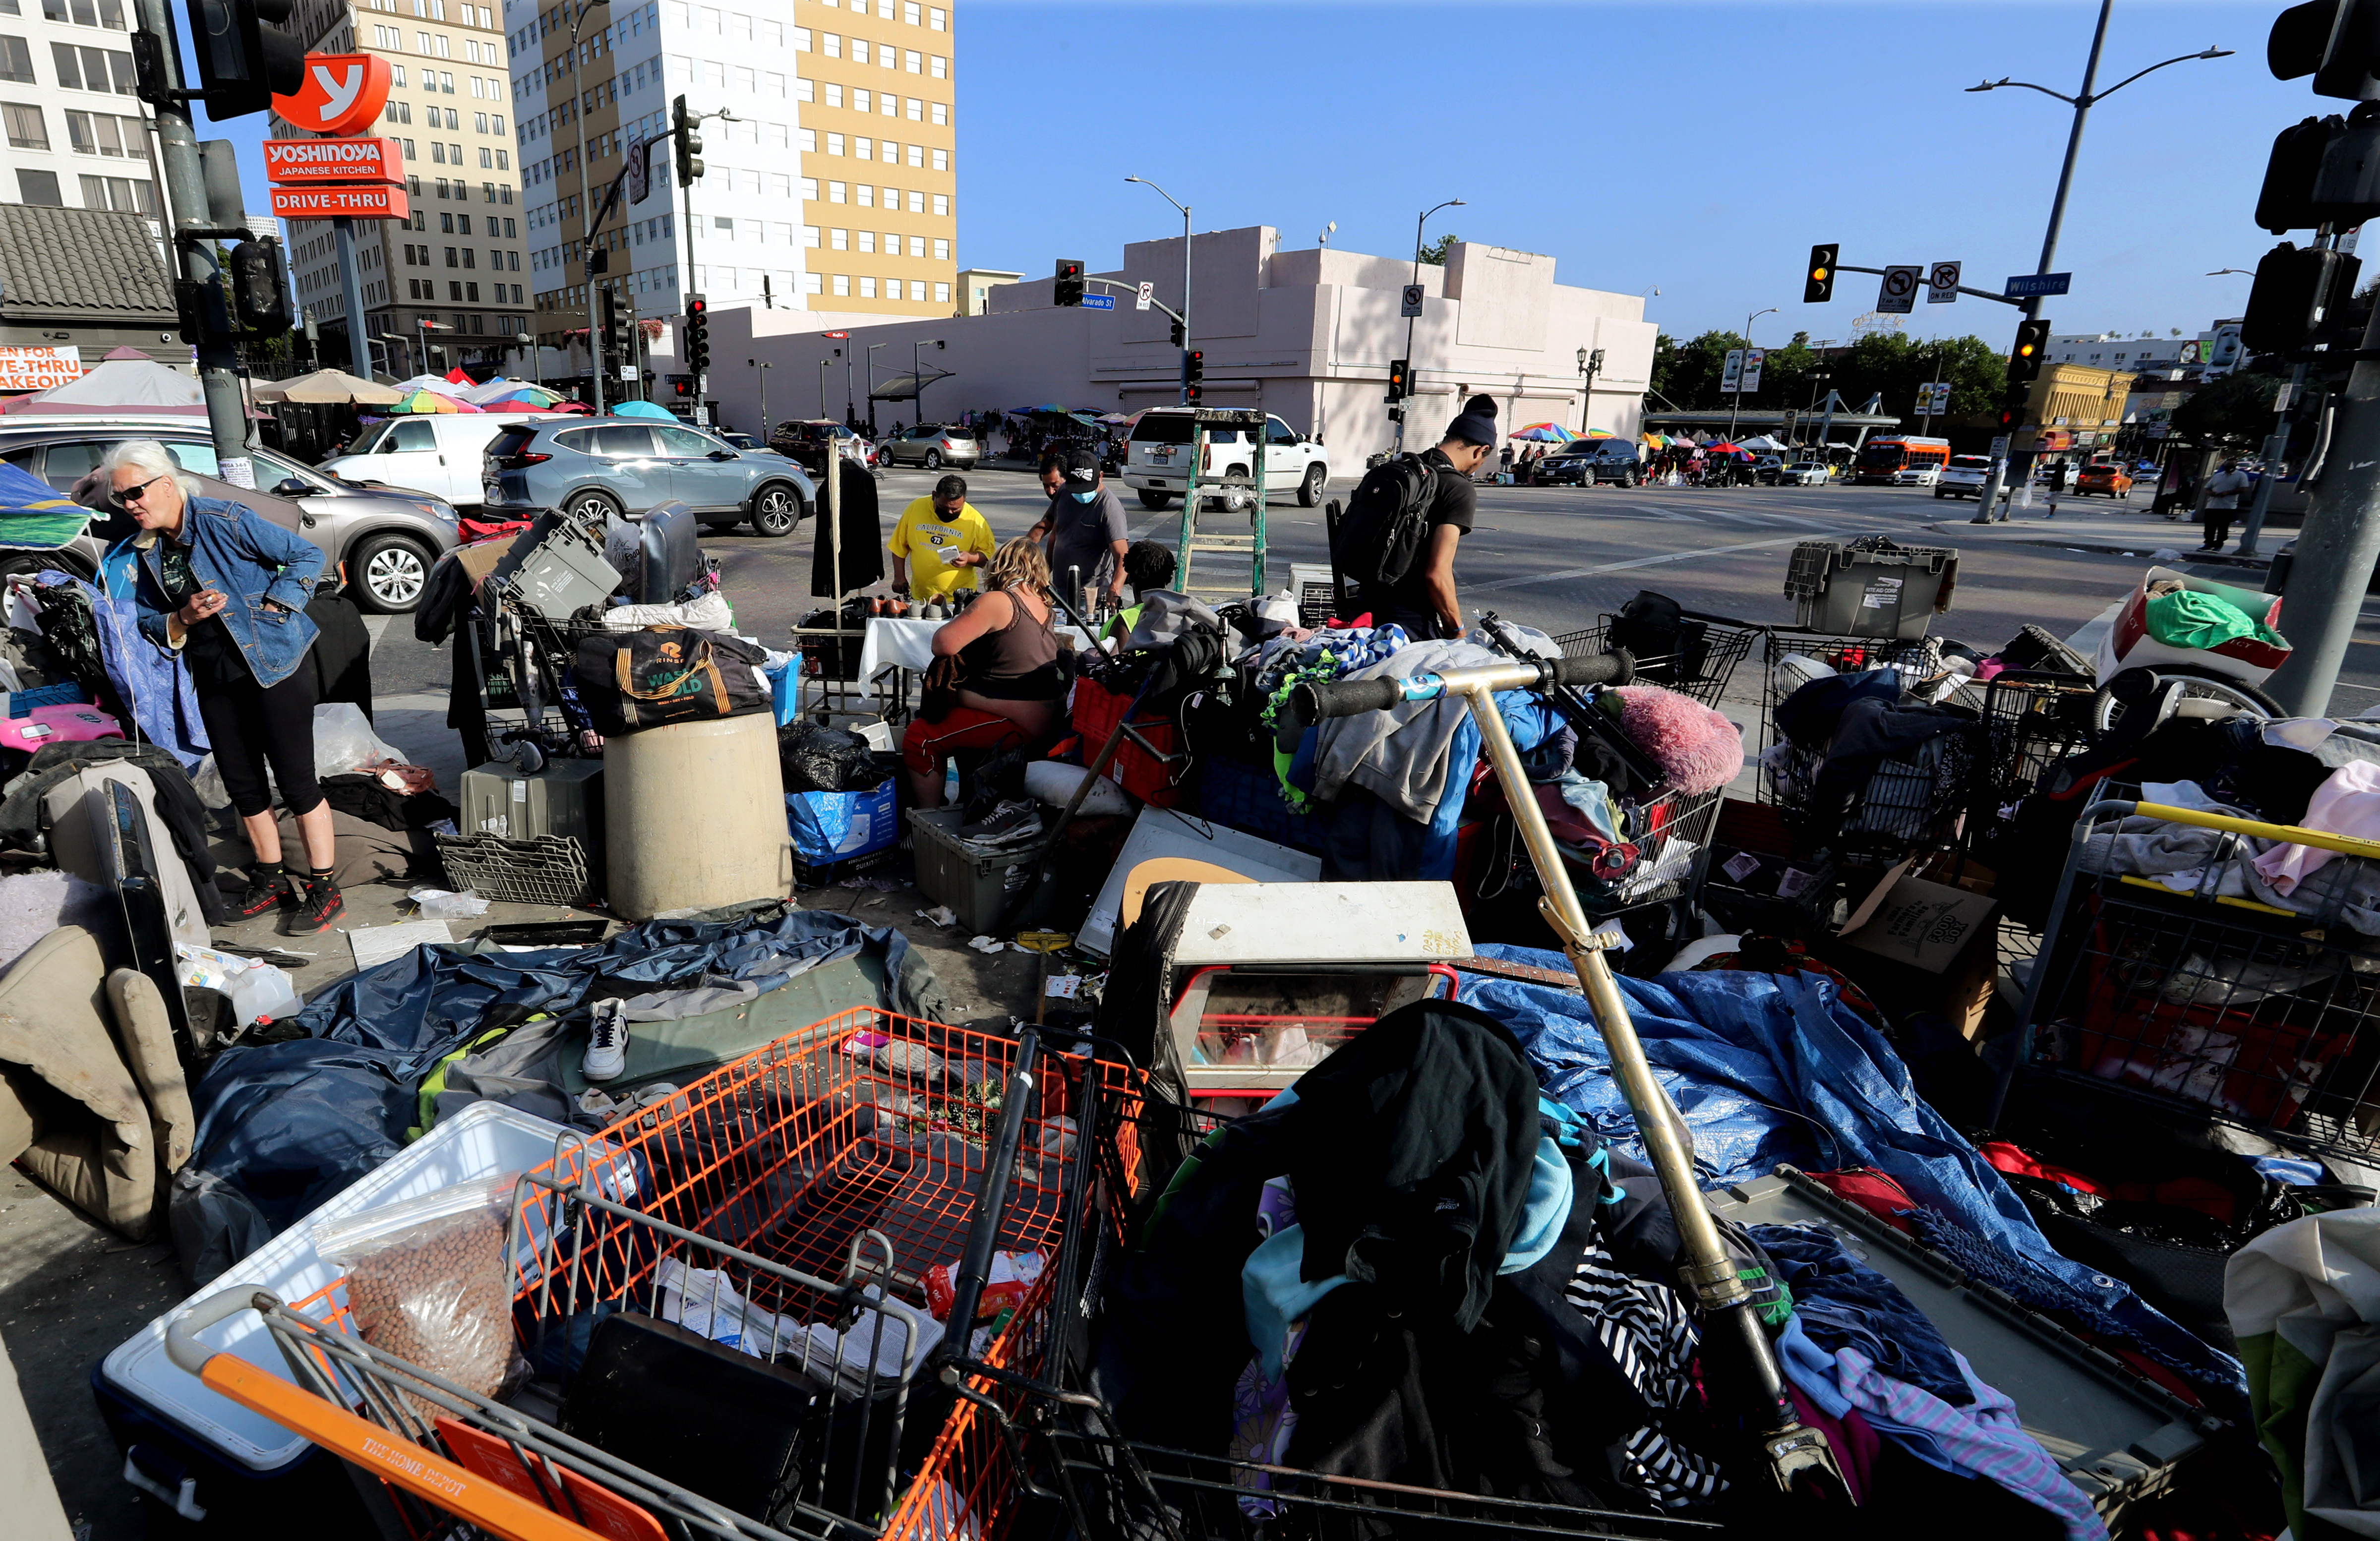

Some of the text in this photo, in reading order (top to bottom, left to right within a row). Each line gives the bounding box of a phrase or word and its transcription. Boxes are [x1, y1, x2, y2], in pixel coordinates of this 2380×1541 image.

[268, 144, 381, 163] YOSHINOYA
[279, 167, 330, 176] JAPANESE
[276, 194, 387, 208] DRIVE-THRU
[2010, 279, 2066, 292] Wilshire
[1082, 297, 1104, 306] Alvarado
[23, 347, 57, 357] FOR
[915, 523, 963, 539] CALIFORNIA
[848, 854, 872, 865] CONDITIONER
[1887, 904, 1916, 935] Farmers
[1899, 905, 1929, 937] Families
[1926, 915, 1956, 944] FOOD
[1943, 921, 1969, 944] BOX
[361, 1437, 390, 1459] THE
[386, 1450, 425, 1477] HOME
[422, 1468, 467, 1497] DEPOT
